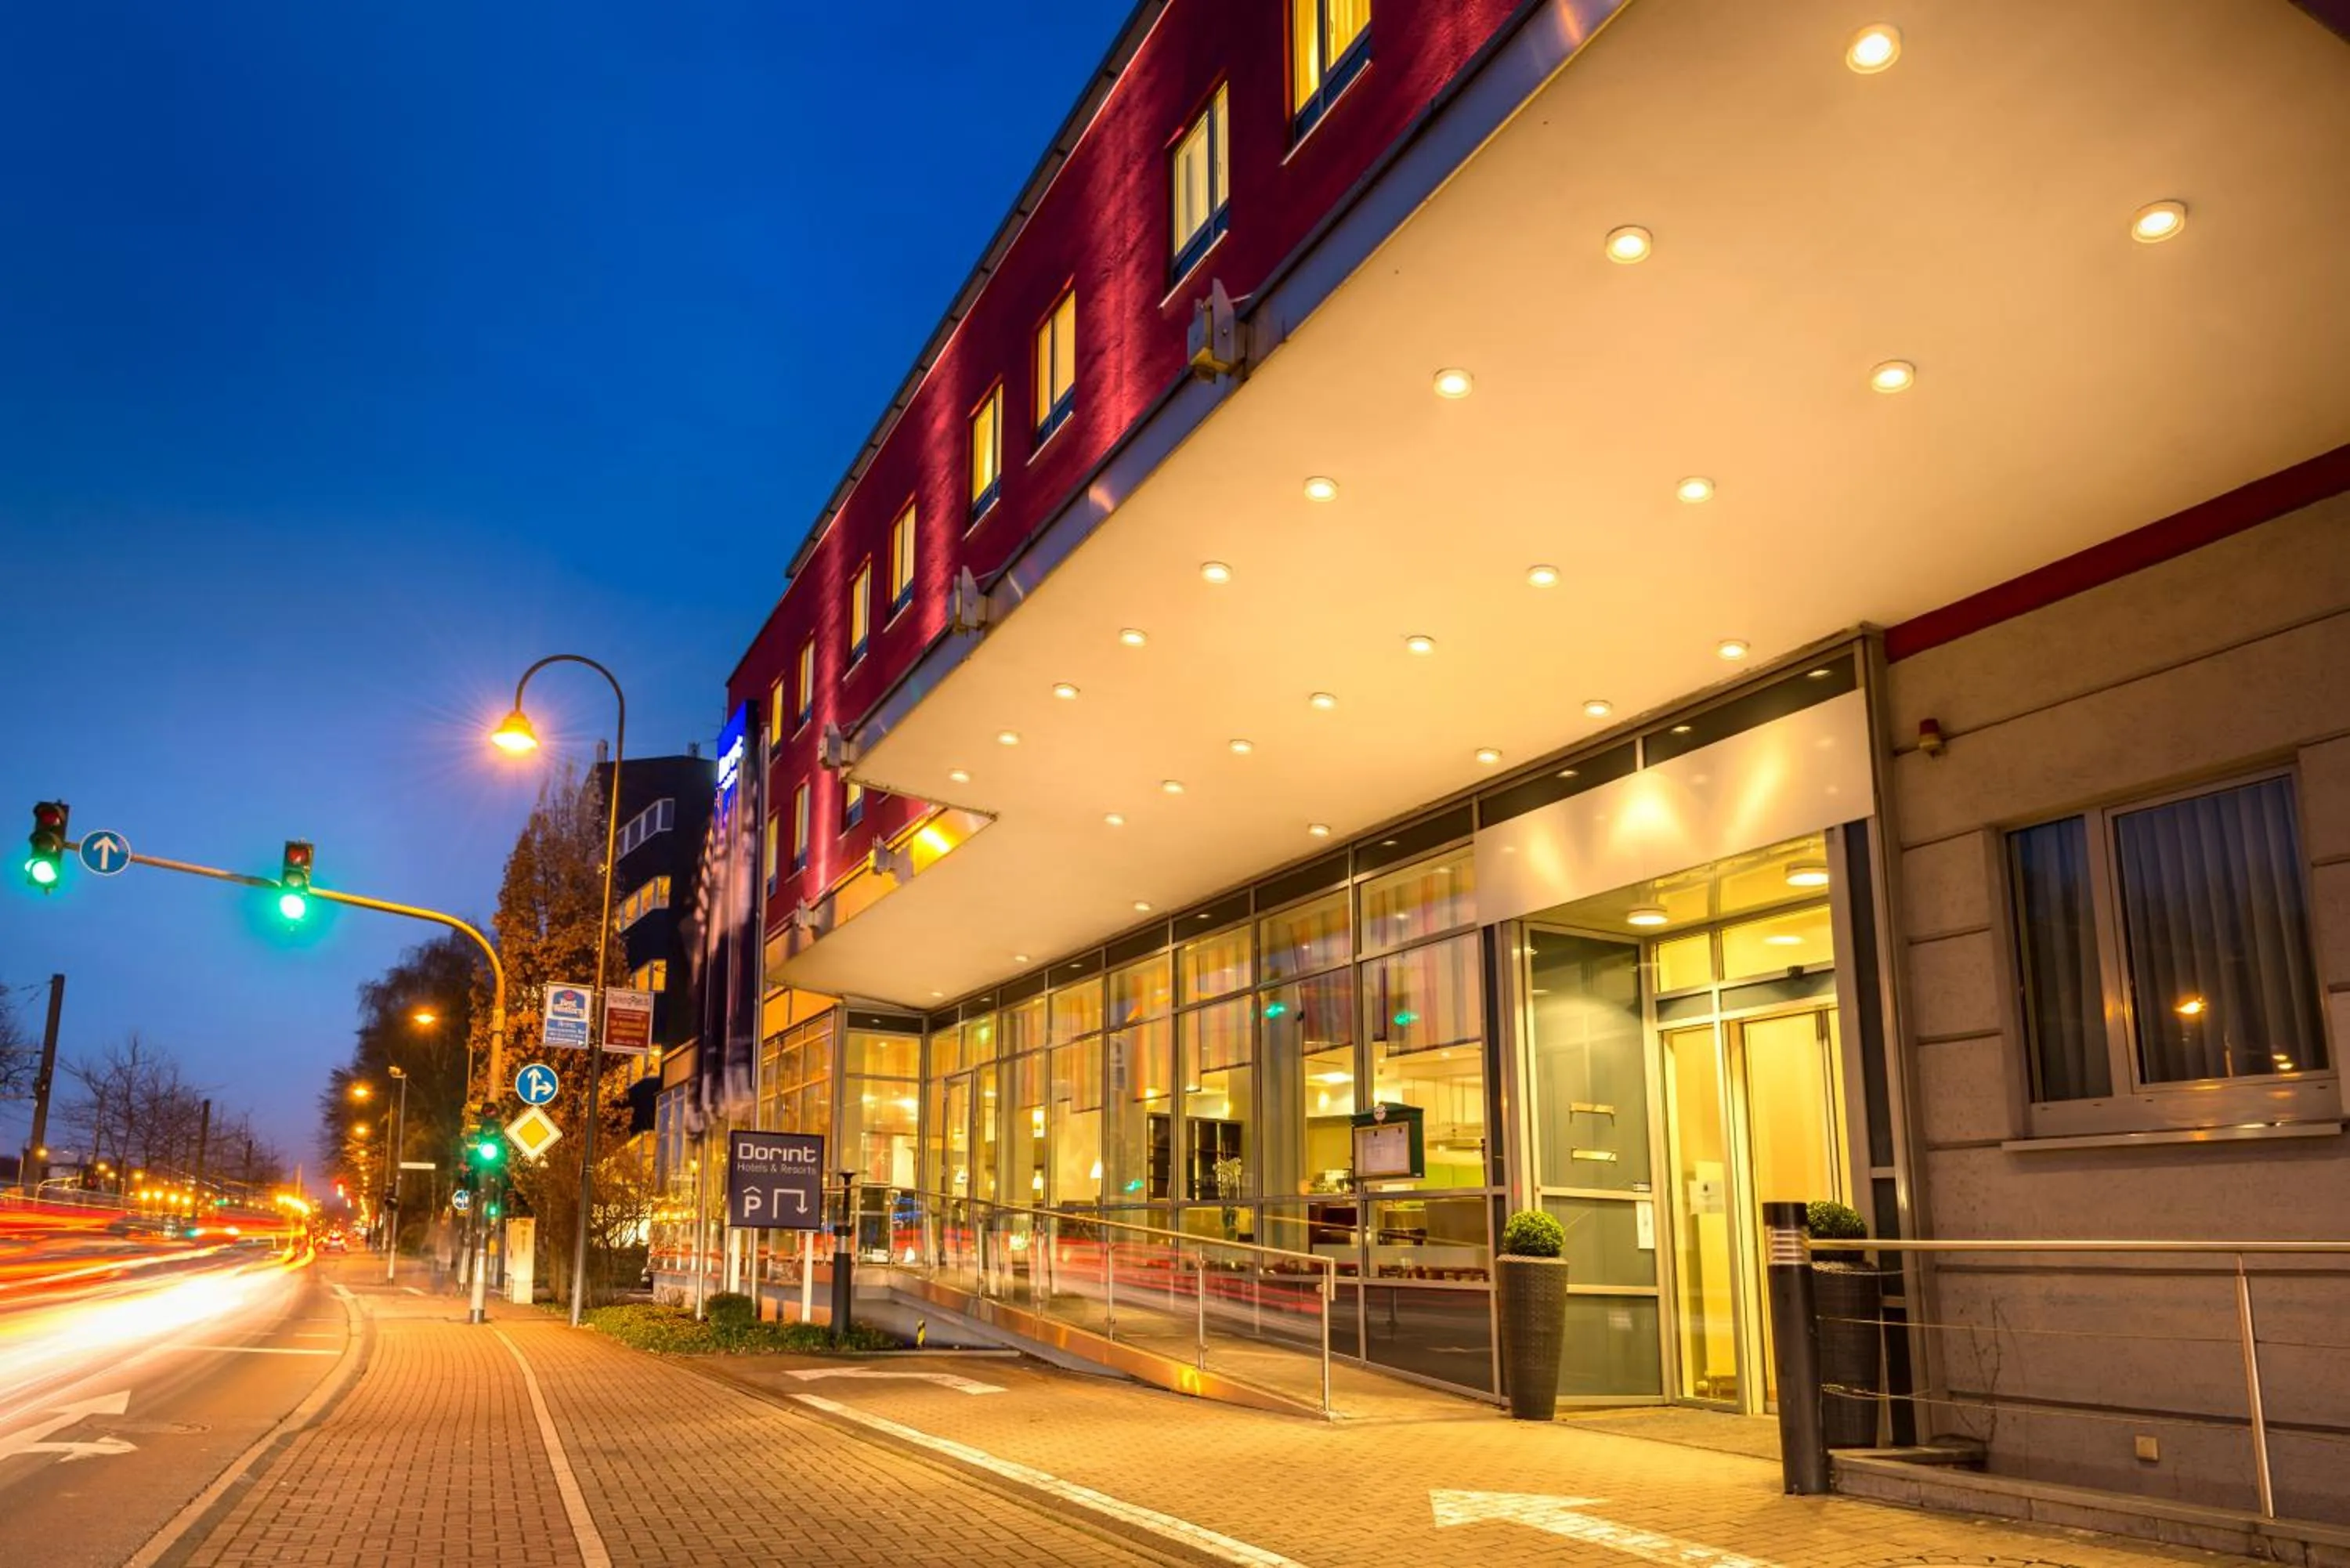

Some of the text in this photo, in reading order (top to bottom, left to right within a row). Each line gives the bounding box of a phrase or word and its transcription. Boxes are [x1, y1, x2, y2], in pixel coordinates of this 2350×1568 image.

[738, 1143, 816, 1162] Dorint
[737, 1163, 816, 1175] Hotels & Resorts
[743, 1196, 761, 1218] P
